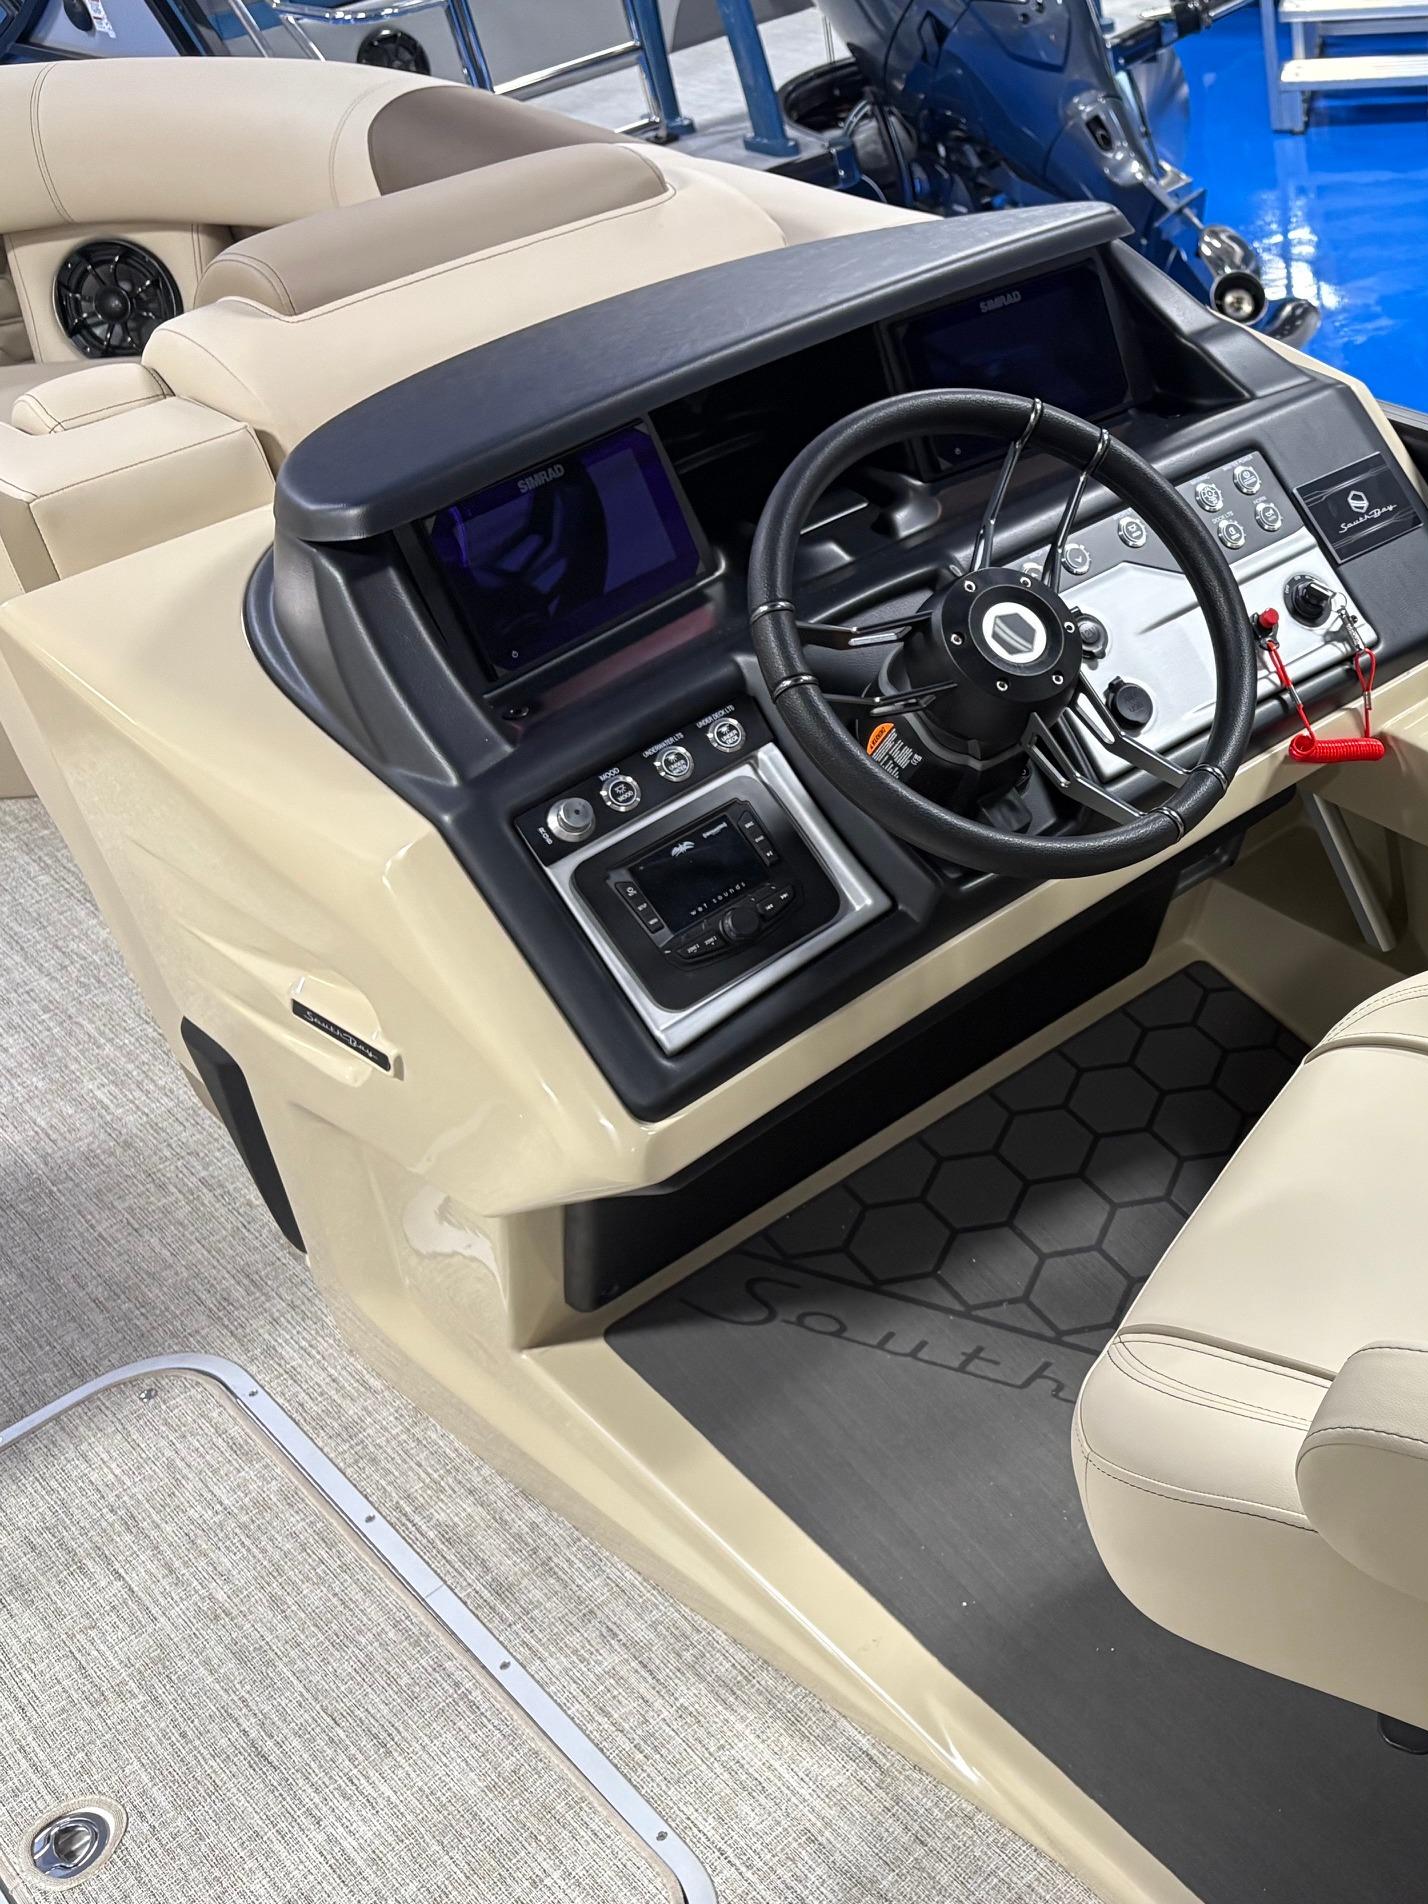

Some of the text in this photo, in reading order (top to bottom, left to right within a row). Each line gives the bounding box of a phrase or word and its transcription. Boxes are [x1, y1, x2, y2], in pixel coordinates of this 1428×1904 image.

[980, 290, 1022, 313] SIMRAD
[517, 463, 565, 493] SIMRAD
[696, 715, 713, 729] UNDER
[598, 767, 620, 781] MOOD
[617, 790, 634, 802] MOOD
[679, 1274, 1080, 1405] South
